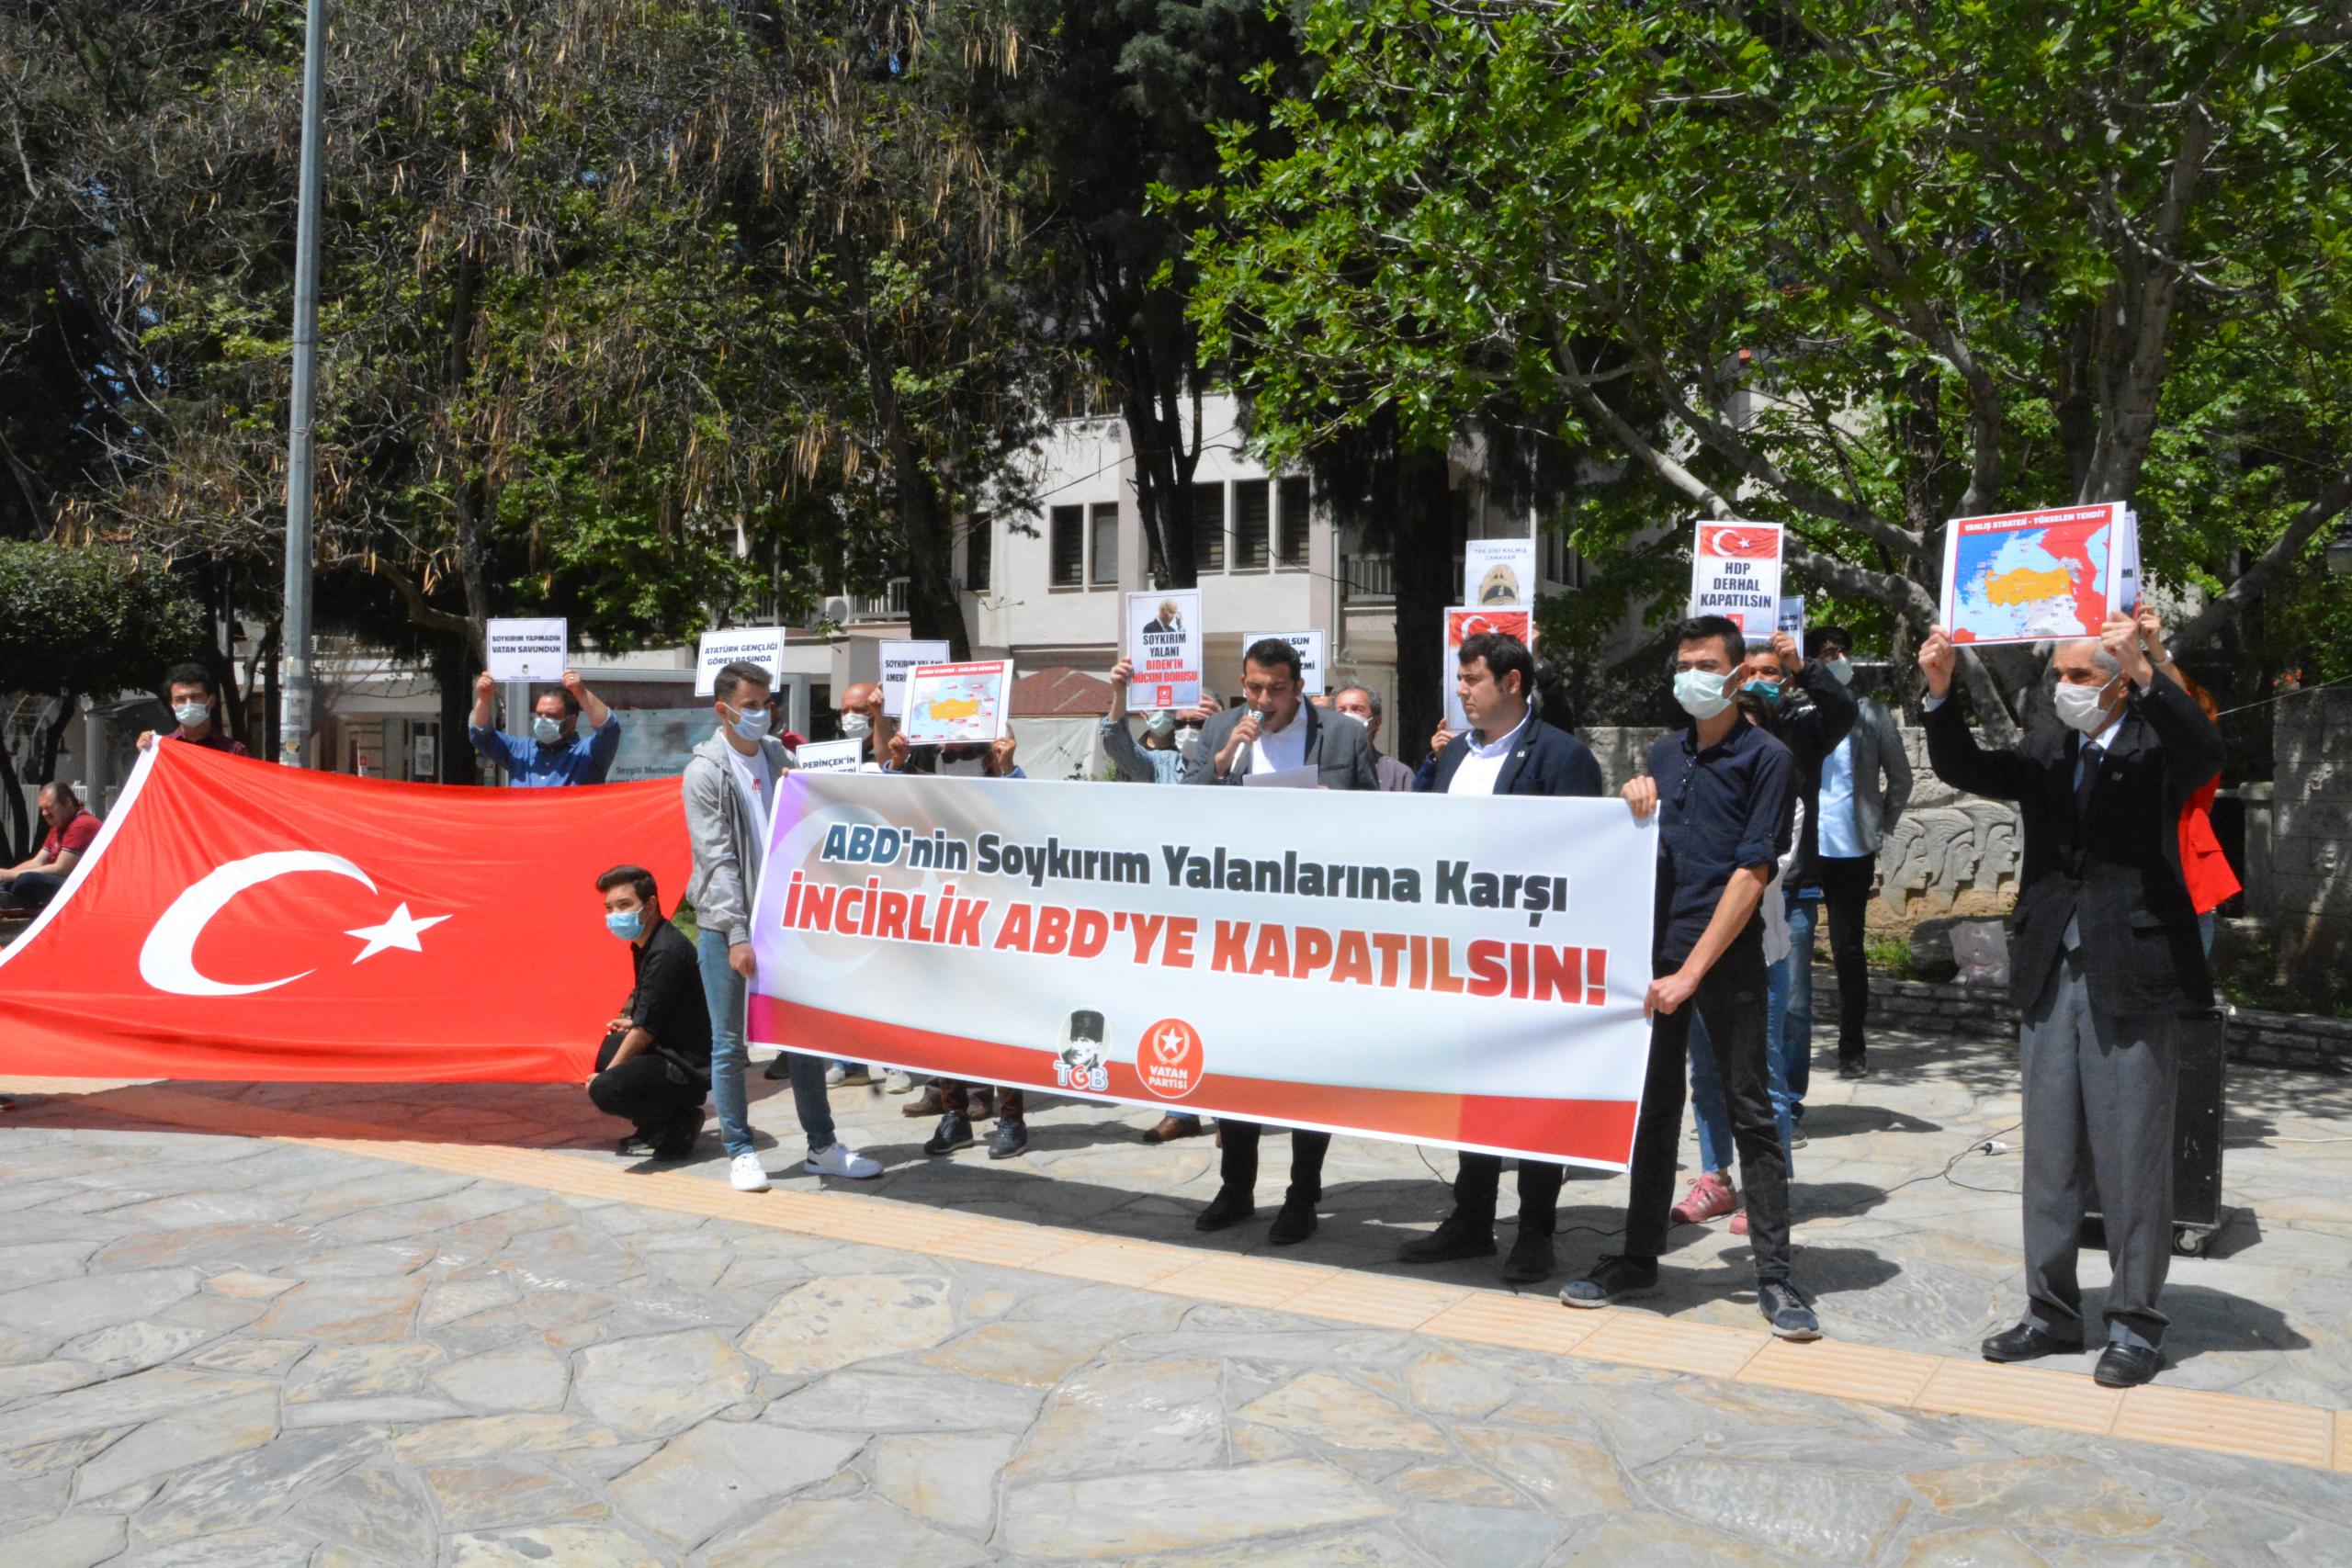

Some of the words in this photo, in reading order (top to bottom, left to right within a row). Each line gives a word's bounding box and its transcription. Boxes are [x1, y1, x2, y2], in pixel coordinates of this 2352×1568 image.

[2033, 514, 2075, 525] YÜKSELEN
[2076, 509, 2106, 520] TEHDİT
[1725, 562, 1750, 575] HDP
[1713, 578, 1760, 592] DERHAL
[1701, 593, 1771, 608] KAPATILSIN
[1143, 633, 1186, 645] SOYKIRIM
[705, 644, 739, 654] ATATÜRK
[741, 641, 778, 652] GENÇLİĞİ
[1150, 647, 1180, 657] YALANI
[707, 656, 734, 666] GÖREV
[886, 660, 916, 668] SOYKIRIM
[886, 671, 908, 682] AMERİ
[1132, 671, 1162, 683] HÜCUM
[1163, 671, 1198, 682] BORUSU
[802, 755, 855, 769] PERİNÇEK'İN
[820, 824, 968, 872] ABD'nin
[977, 833, 1150, 887] Soykırım
[1162, 843, 1422, 903] Yalanlarına
[1435, 860, 1567, 928] Karşı
[781, 871, 989, 948] İNCİRLİK
[992, 902, 1199, 969] ABD'YE
[1211, 919, 1607, 1007] KAPATILSIN!
[1054, 1061, 1108, 1090] TGB
[1149, 1065, 1188, 1079] VATAN
[1148, 1076, 1188, 1089] PARTİSİ
